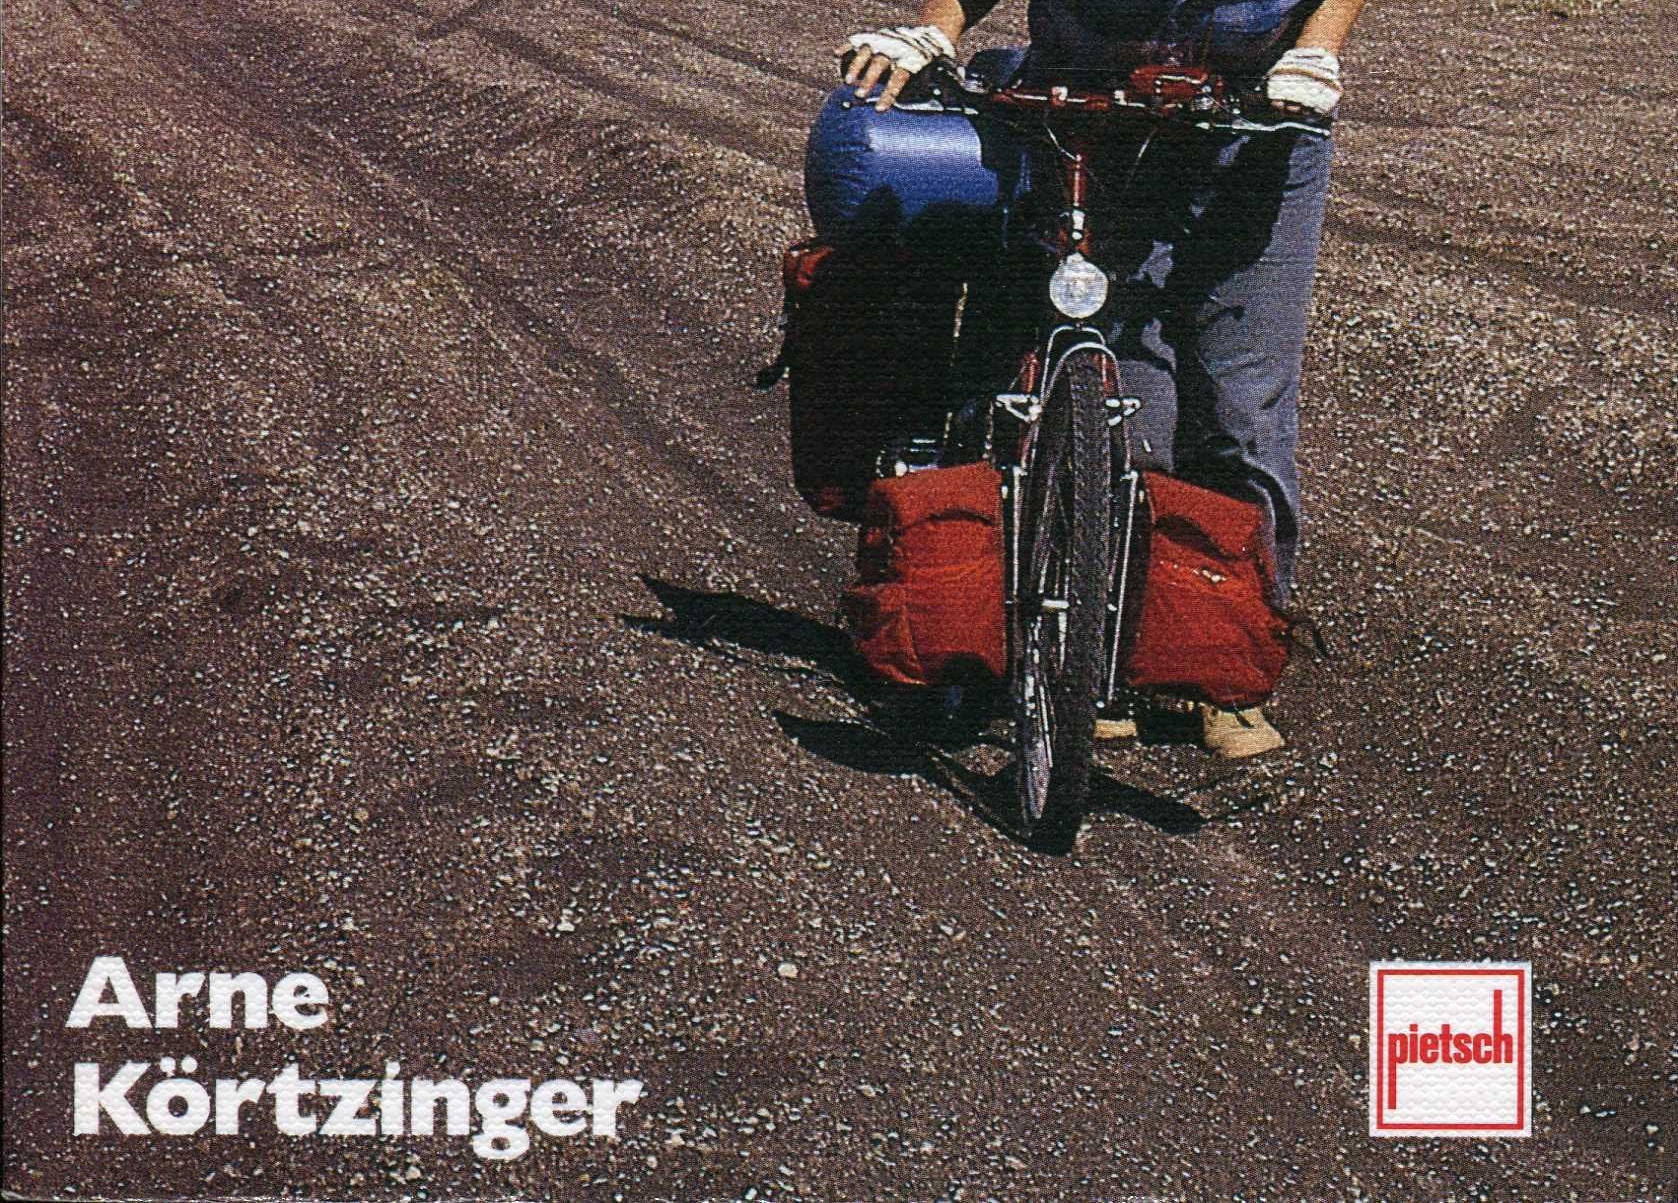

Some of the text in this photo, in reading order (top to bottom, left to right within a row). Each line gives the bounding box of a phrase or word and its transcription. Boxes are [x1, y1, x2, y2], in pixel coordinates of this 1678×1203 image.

[66, 955, 330, 1032] Arne
[1387, 989, 1513, 1110] pietsch
[73, 1055, 644, 1162] Körtzinger
